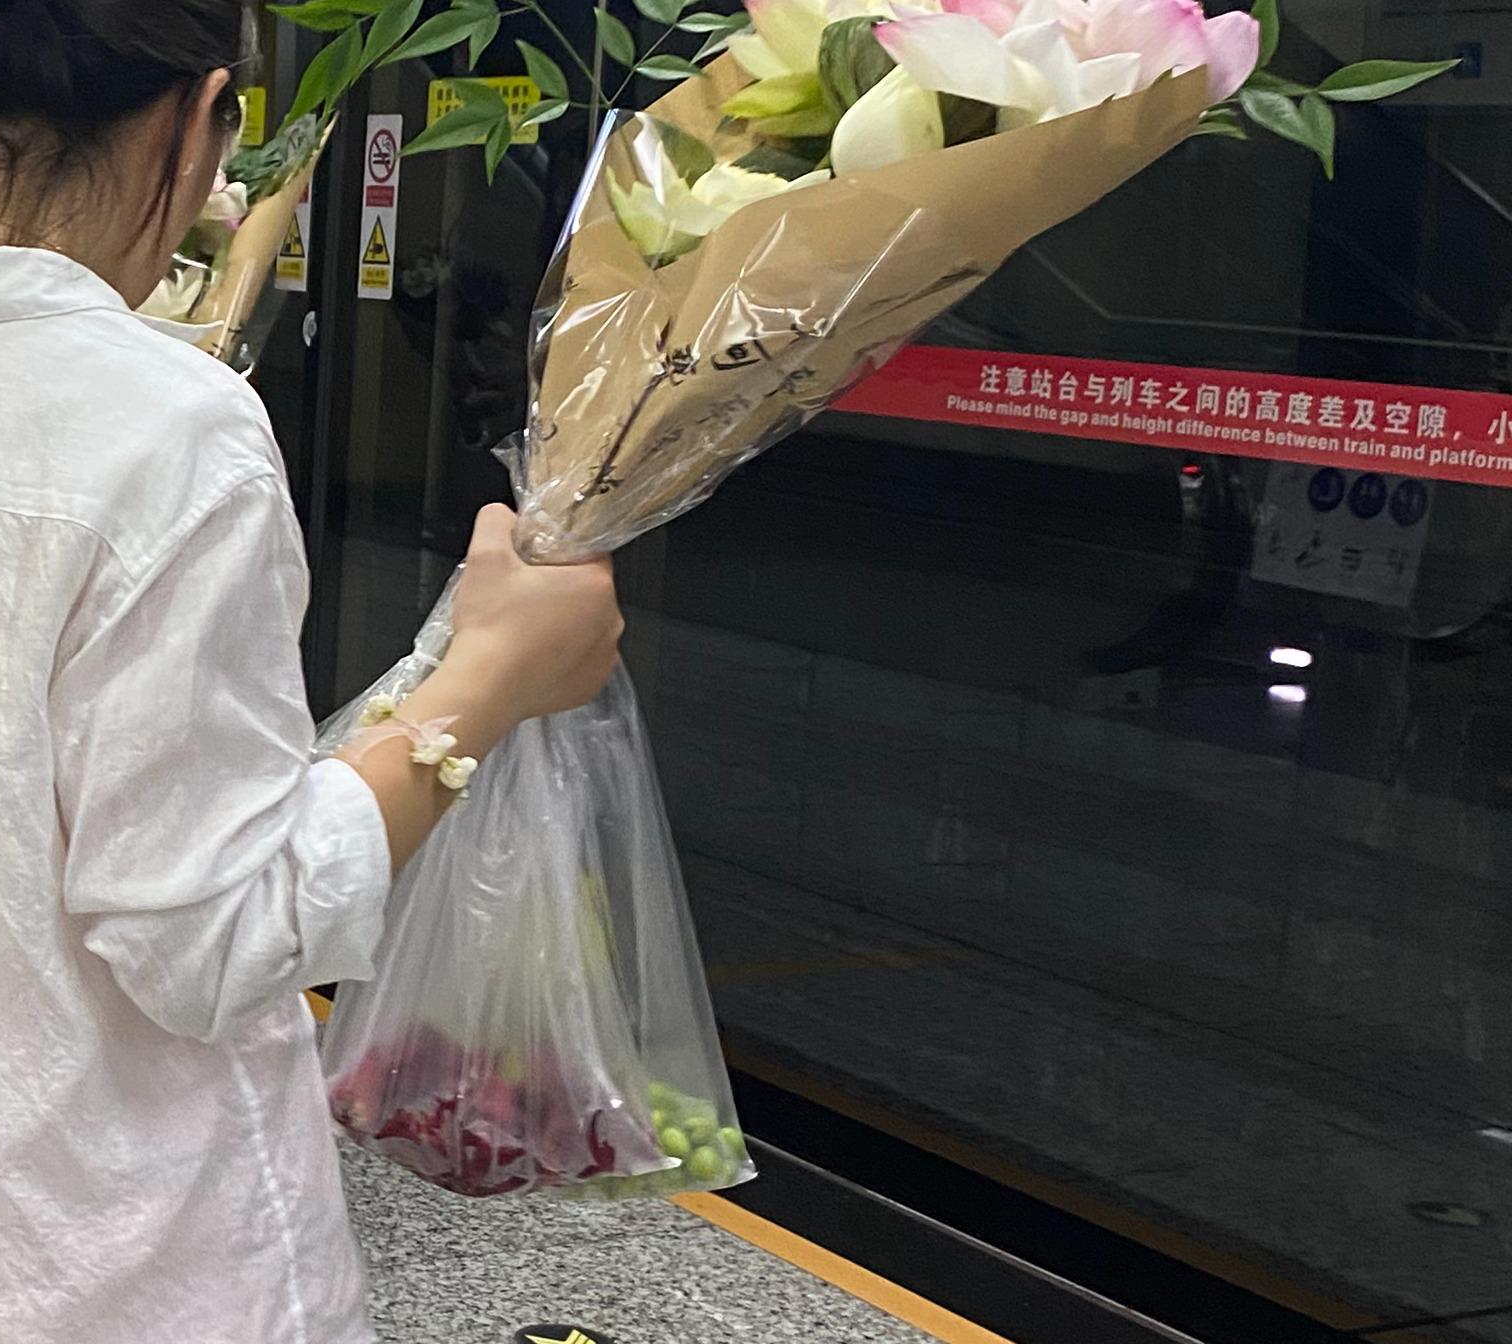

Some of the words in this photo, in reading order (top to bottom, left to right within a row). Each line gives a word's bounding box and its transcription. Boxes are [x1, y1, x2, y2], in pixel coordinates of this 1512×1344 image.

[947, 394, 993, 414] Please
[995, 403, 1032, 419] mind
[1034, 404, 1058, 420] the
[1060, 410, 1089, 428] gap
[1091, 413, 1119, 427] and
[1122, 413, 1173, 437] height
[1175, 419, 1261, 443] difference
[1265, 427, 1340, 452] between
[1343, 436, 1387, 457] train
[1390, 444, 1426, 461] and
